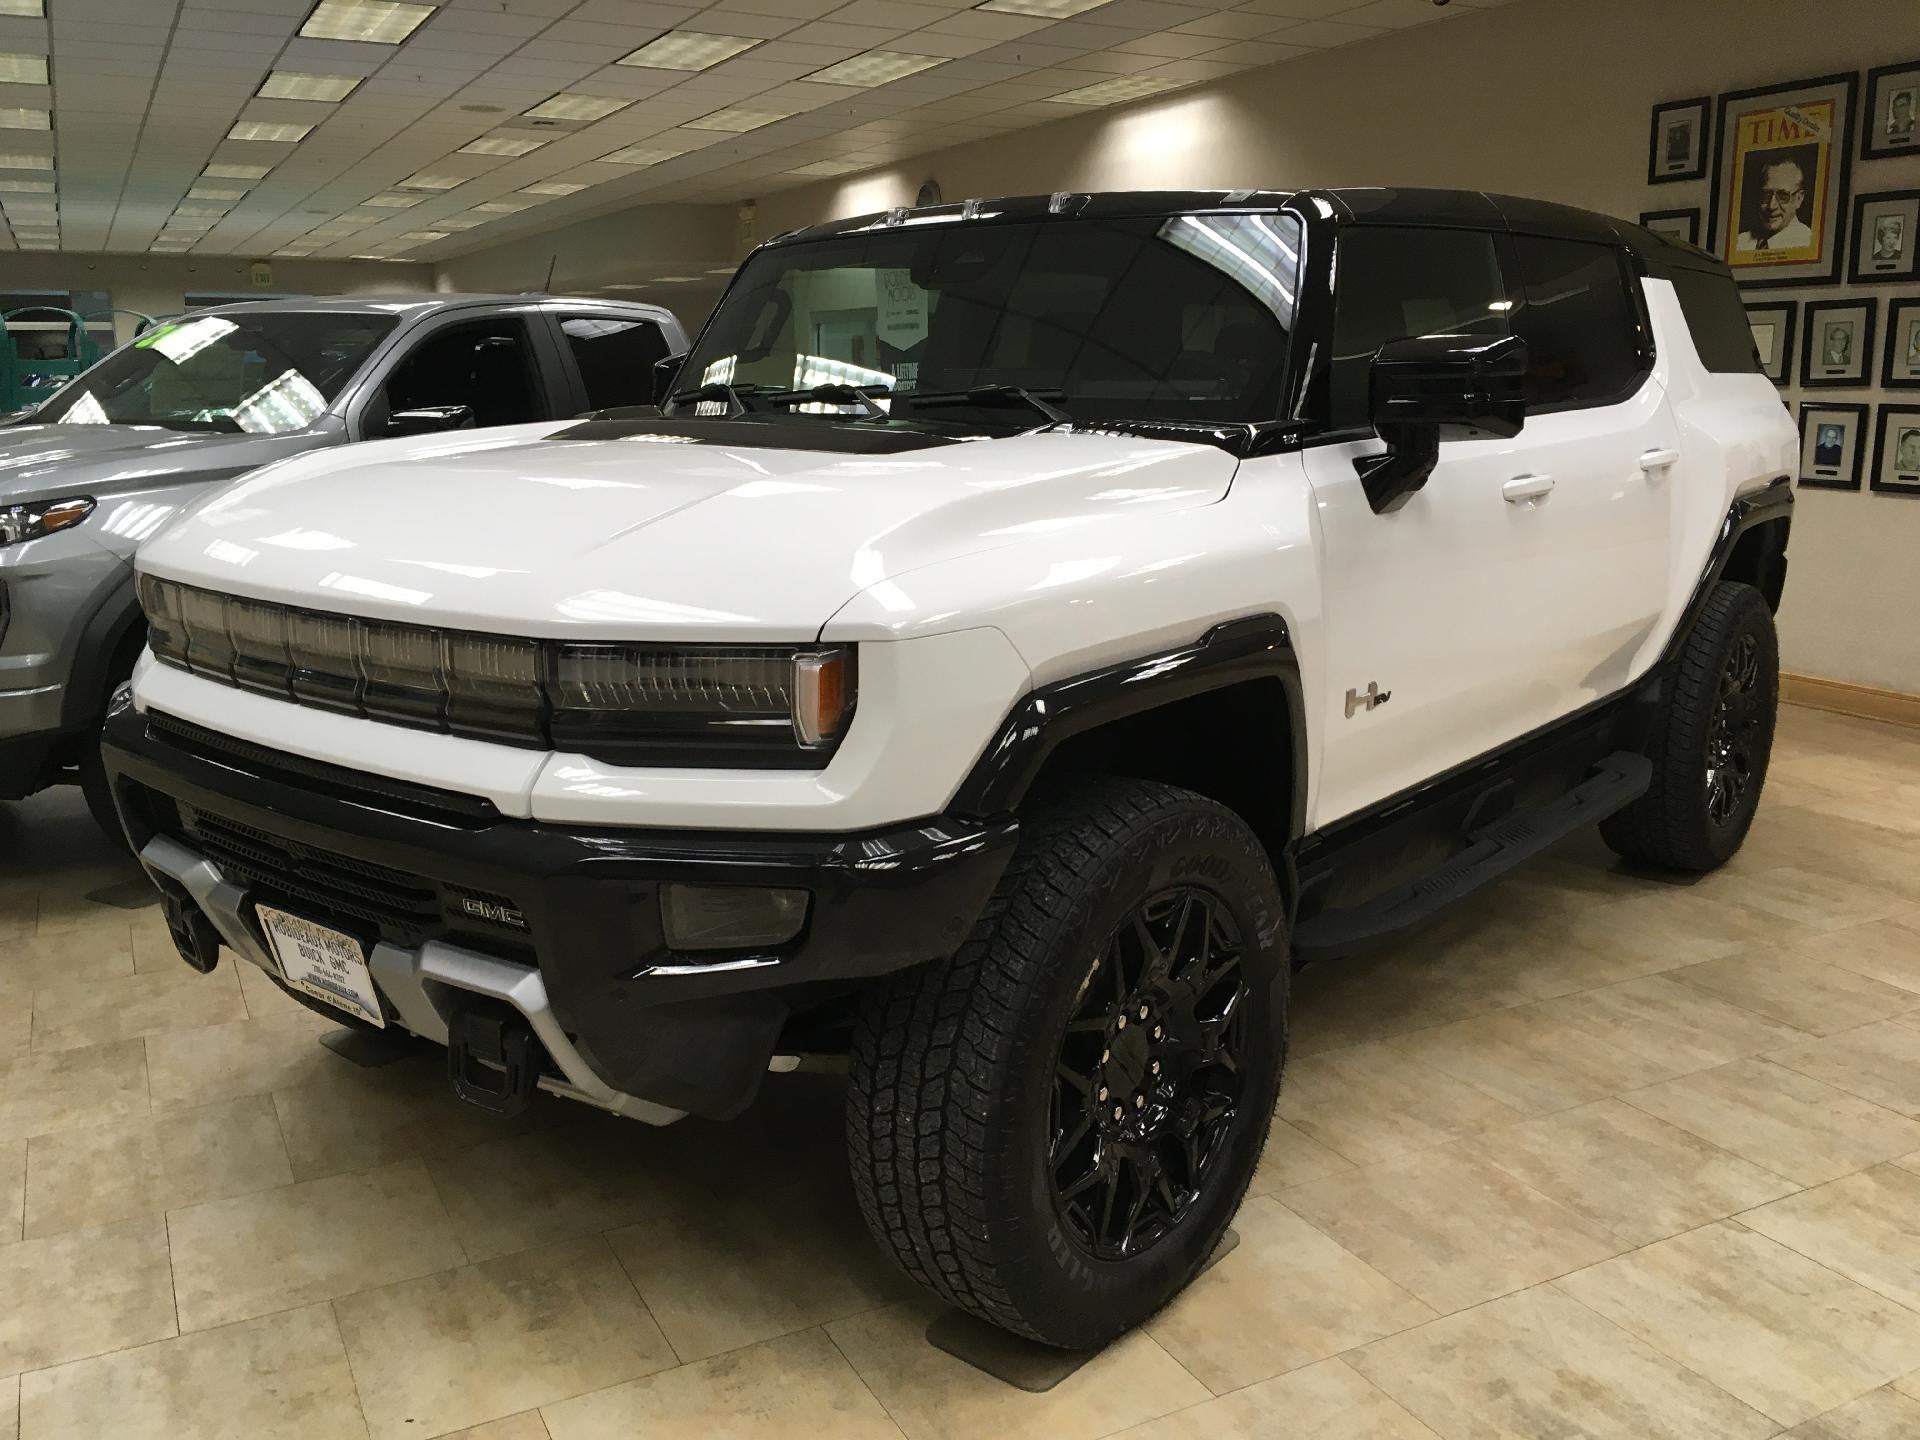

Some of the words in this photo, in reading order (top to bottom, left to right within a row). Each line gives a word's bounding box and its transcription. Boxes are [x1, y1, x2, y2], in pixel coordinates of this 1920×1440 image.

[462, 898, 525, 927] GMC
[297, 943, 325, 964] BUICK
[329, 955, 349, 974] GMC
[323, 939, 363, 965] MOTORS
